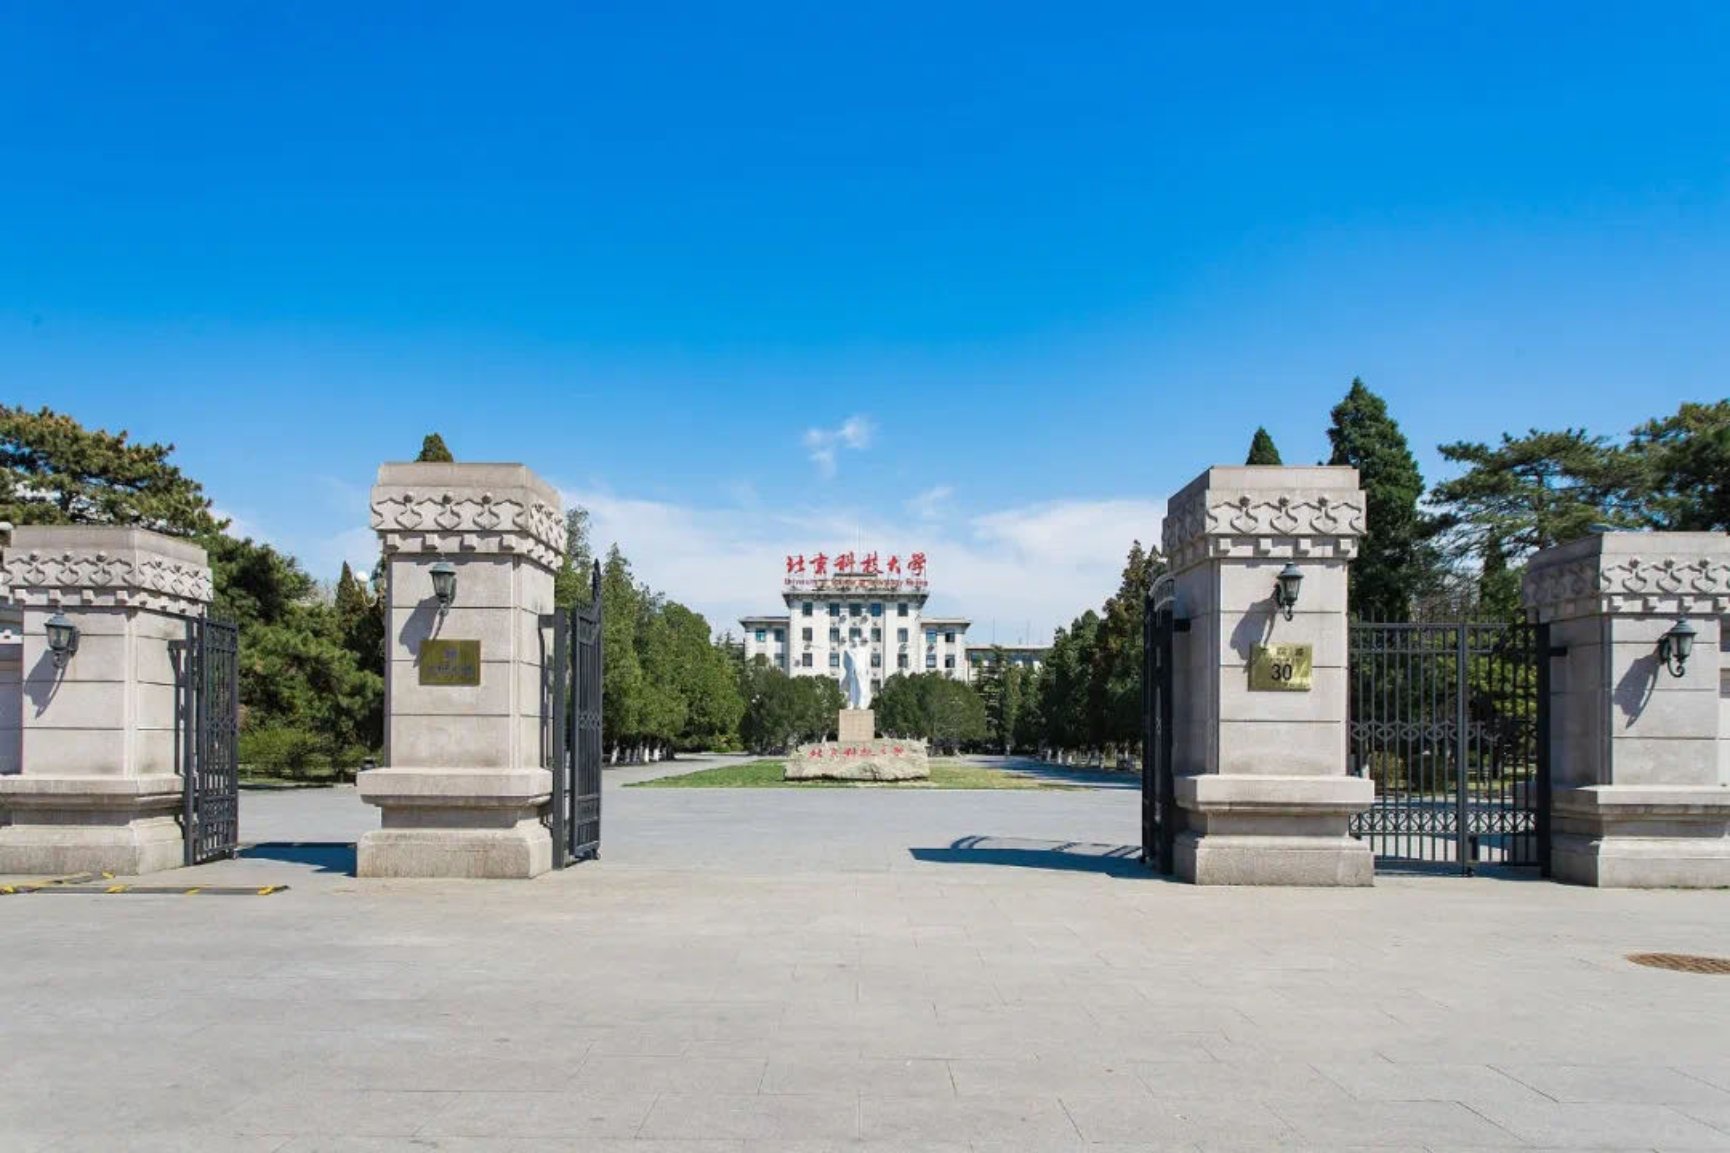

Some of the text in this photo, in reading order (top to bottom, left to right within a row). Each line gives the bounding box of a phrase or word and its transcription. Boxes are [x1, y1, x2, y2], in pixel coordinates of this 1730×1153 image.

[786, 551, 927, 576] 北京科技大学
[1271, 663, 1292, 681] 30
